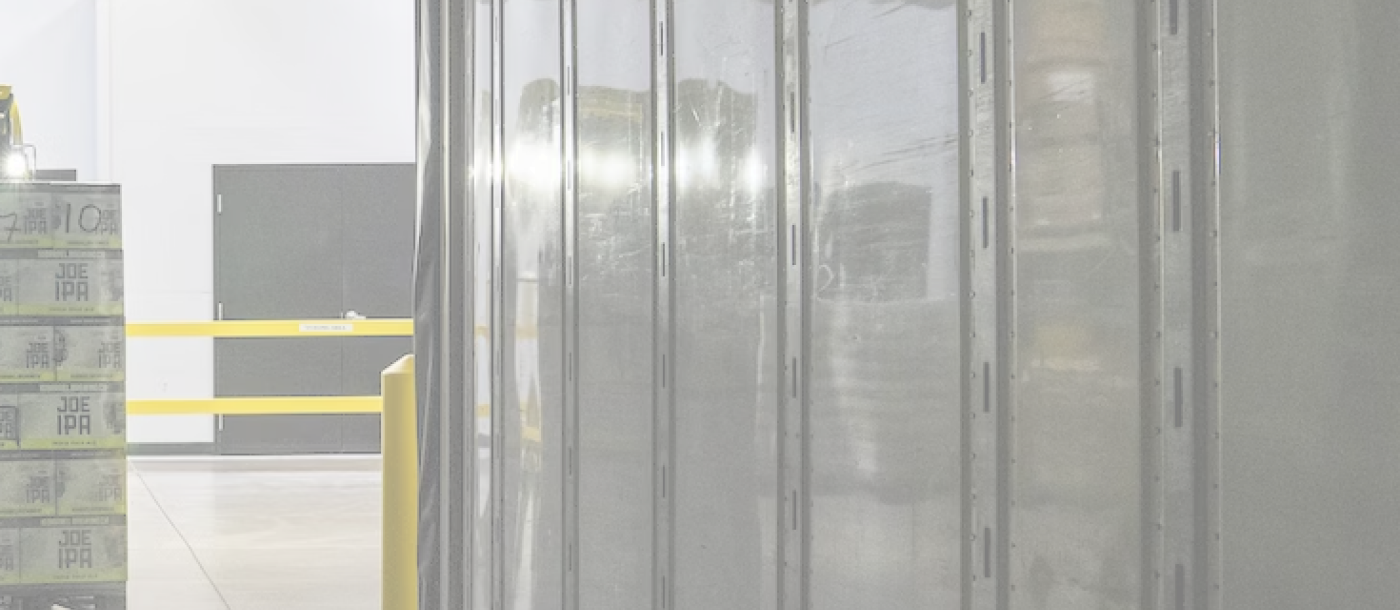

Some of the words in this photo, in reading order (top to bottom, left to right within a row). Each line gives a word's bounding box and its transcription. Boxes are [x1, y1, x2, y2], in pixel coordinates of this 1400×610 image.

[24, 208, 47, 219] JOE
[24, 220, 47, 235] IPA
[55, 263, 88, 279] JOE
[55, 281, 88, 301] IPA
[26, 342, 49, 353] JOE
[98, 342, 121, 353] JOE
[26, 354, 50, 368] IPA
[98, 354, 121, 368] IPA
[57, 396, 90, 412] JOE
[57, 415, 91, 435] IPA
[26, 489, 50, 504] IPA
[99, 486, 122, 502] IPA
[58, 529, 92, 545] JOE
[58, 548, 92, 569] IPA
